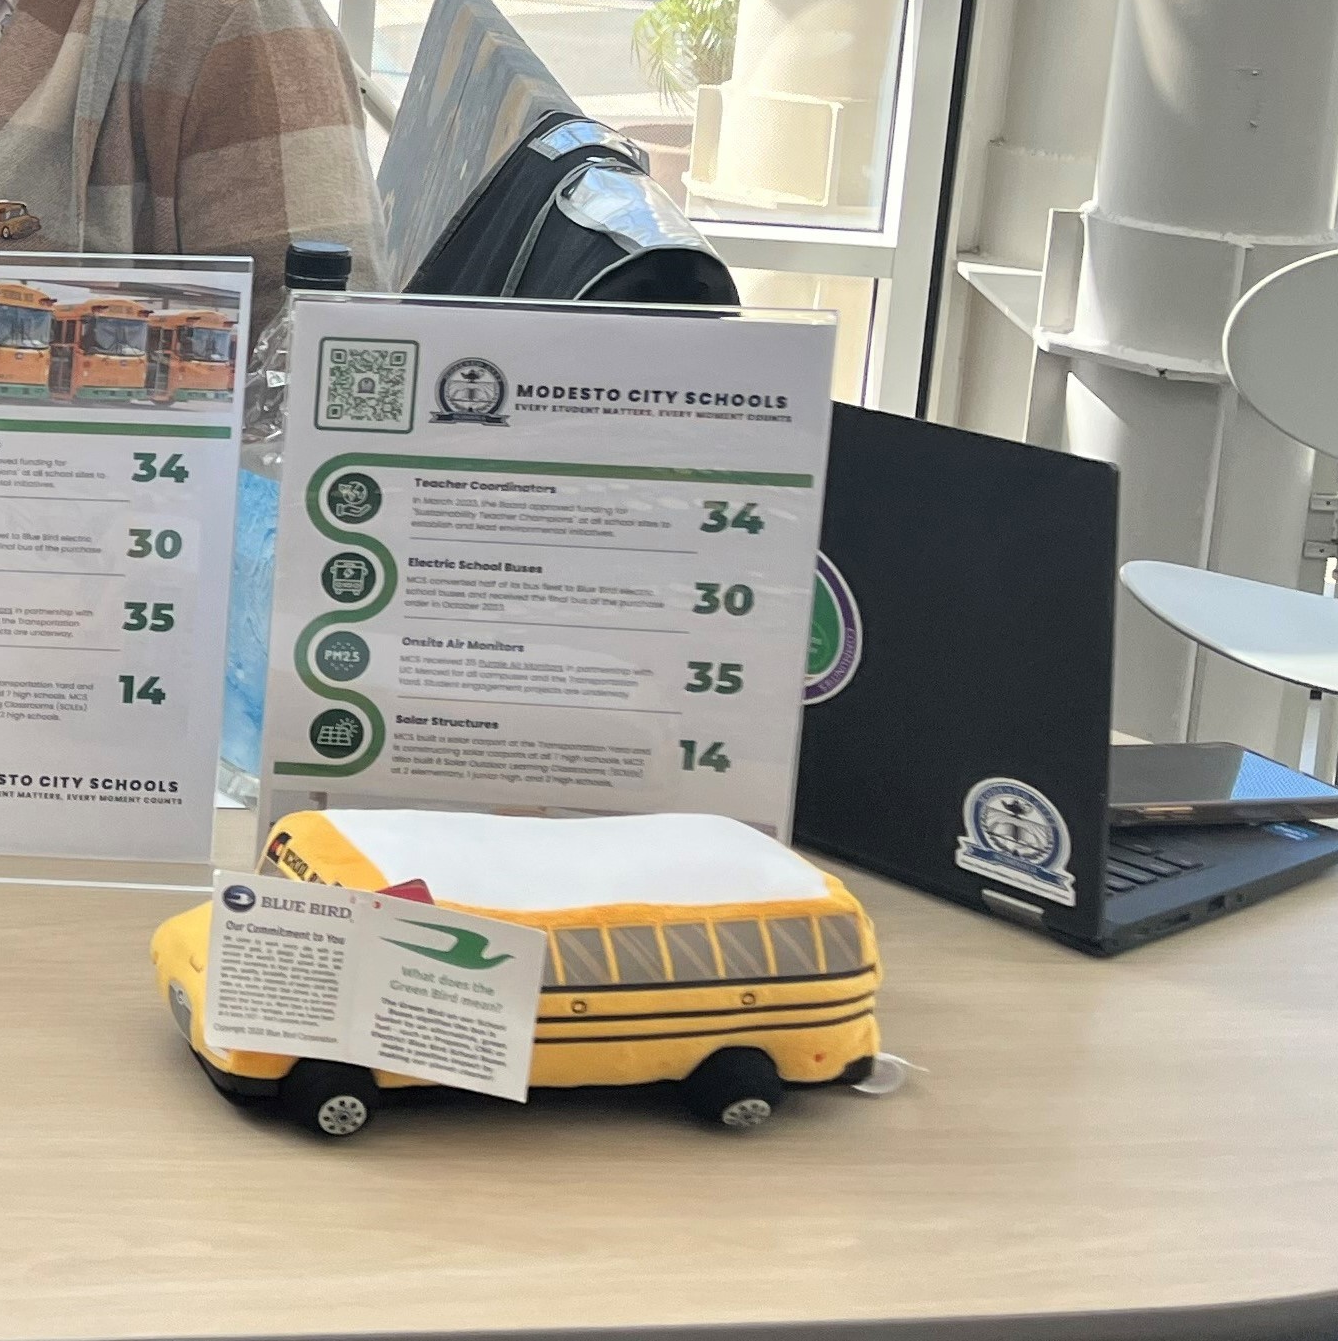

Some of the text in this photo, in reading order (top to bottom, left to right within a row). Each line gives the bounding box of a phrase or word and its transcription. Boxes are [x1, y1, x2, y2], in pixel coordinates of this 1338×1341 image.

[516, 384, 787, 409] MODESTO CITY SCHOOLS
[132, 452, 189, 483] 34
[415, 475, 557, 494] Teacher Coordinators
[699, 500, 765, 535] 34
[126, 528, 182, 559] 30
[407, 555, 543, 574] Electric School Buses
[692, 582, 755, 617] 30
[121, 601, 175, 633] 35
[401, 634, 524, 653] Onsite Air Monitors
[118, 675, 166, 705] 14
[684, 661, 744, 695] 35
[395, 712, 499, 730] Solar Structures
[679, 739, 731, 773] 14
[16, 791, 62, 799] MATTERS,
[66, 793, 96, 801] EVERY
[98, 794, 141, 802] MOMENT
[142, 796, 182, 805] COUNTS
[39, 775, 83, 788] CITY
[89, 777, 179, 793] SCHOOLS
[261, 895, 352, 920] BLUE BIRD
[225, 918, 346, 943] Our Commitment to You
[389, 978, 503, 1012] Green Bird mean?
[401, 964, 495, 996] What does the
